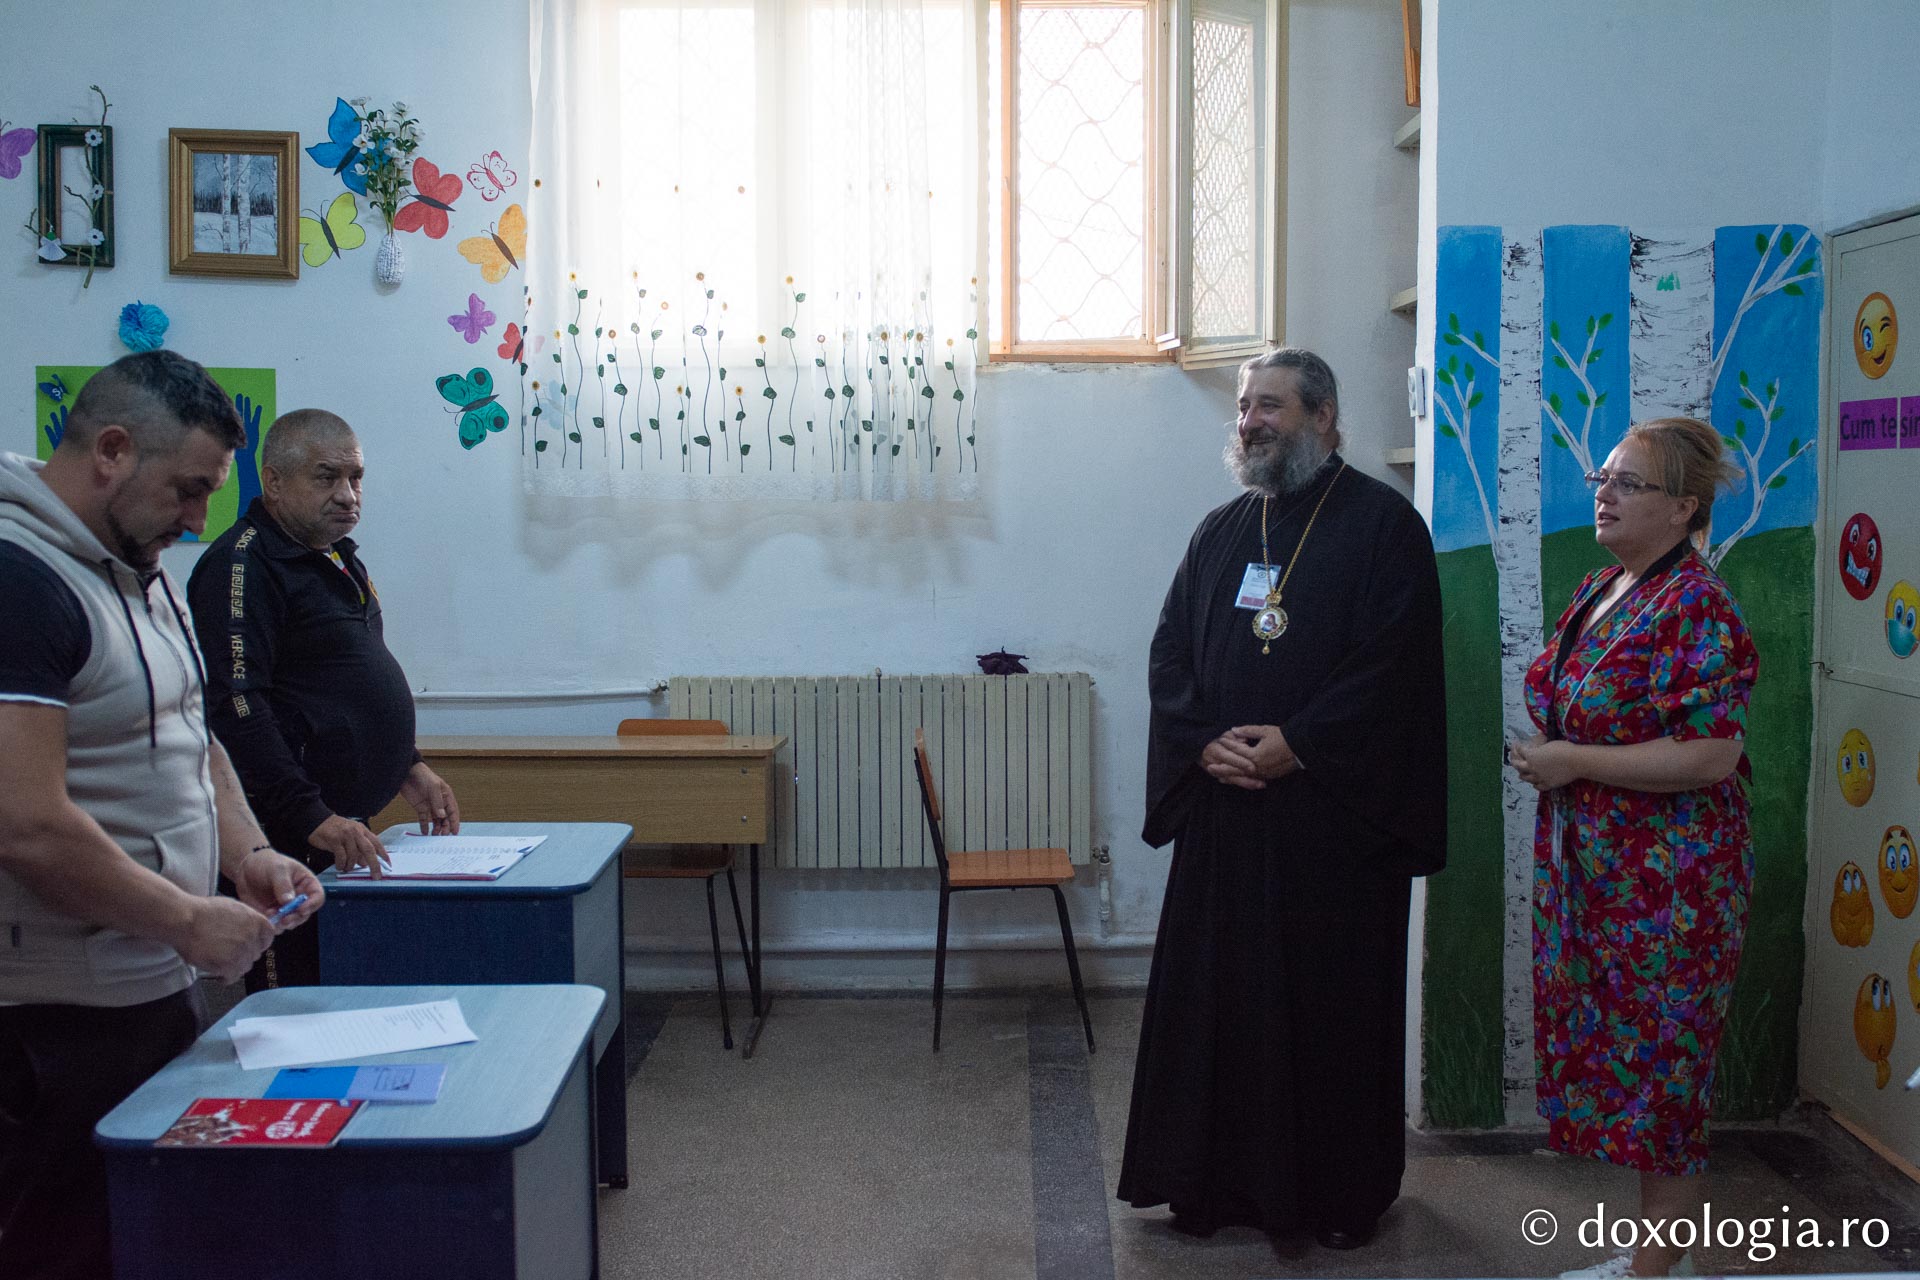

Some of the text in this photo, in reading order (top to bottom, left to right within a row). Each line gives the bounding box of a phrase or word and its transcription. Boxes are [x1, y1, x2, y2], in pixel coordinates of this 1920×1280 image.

[1841, 413, 1876, 440] Cum
[1880, 413, 1897, 438] te
[231, 634, 246, 680] VERSACE
